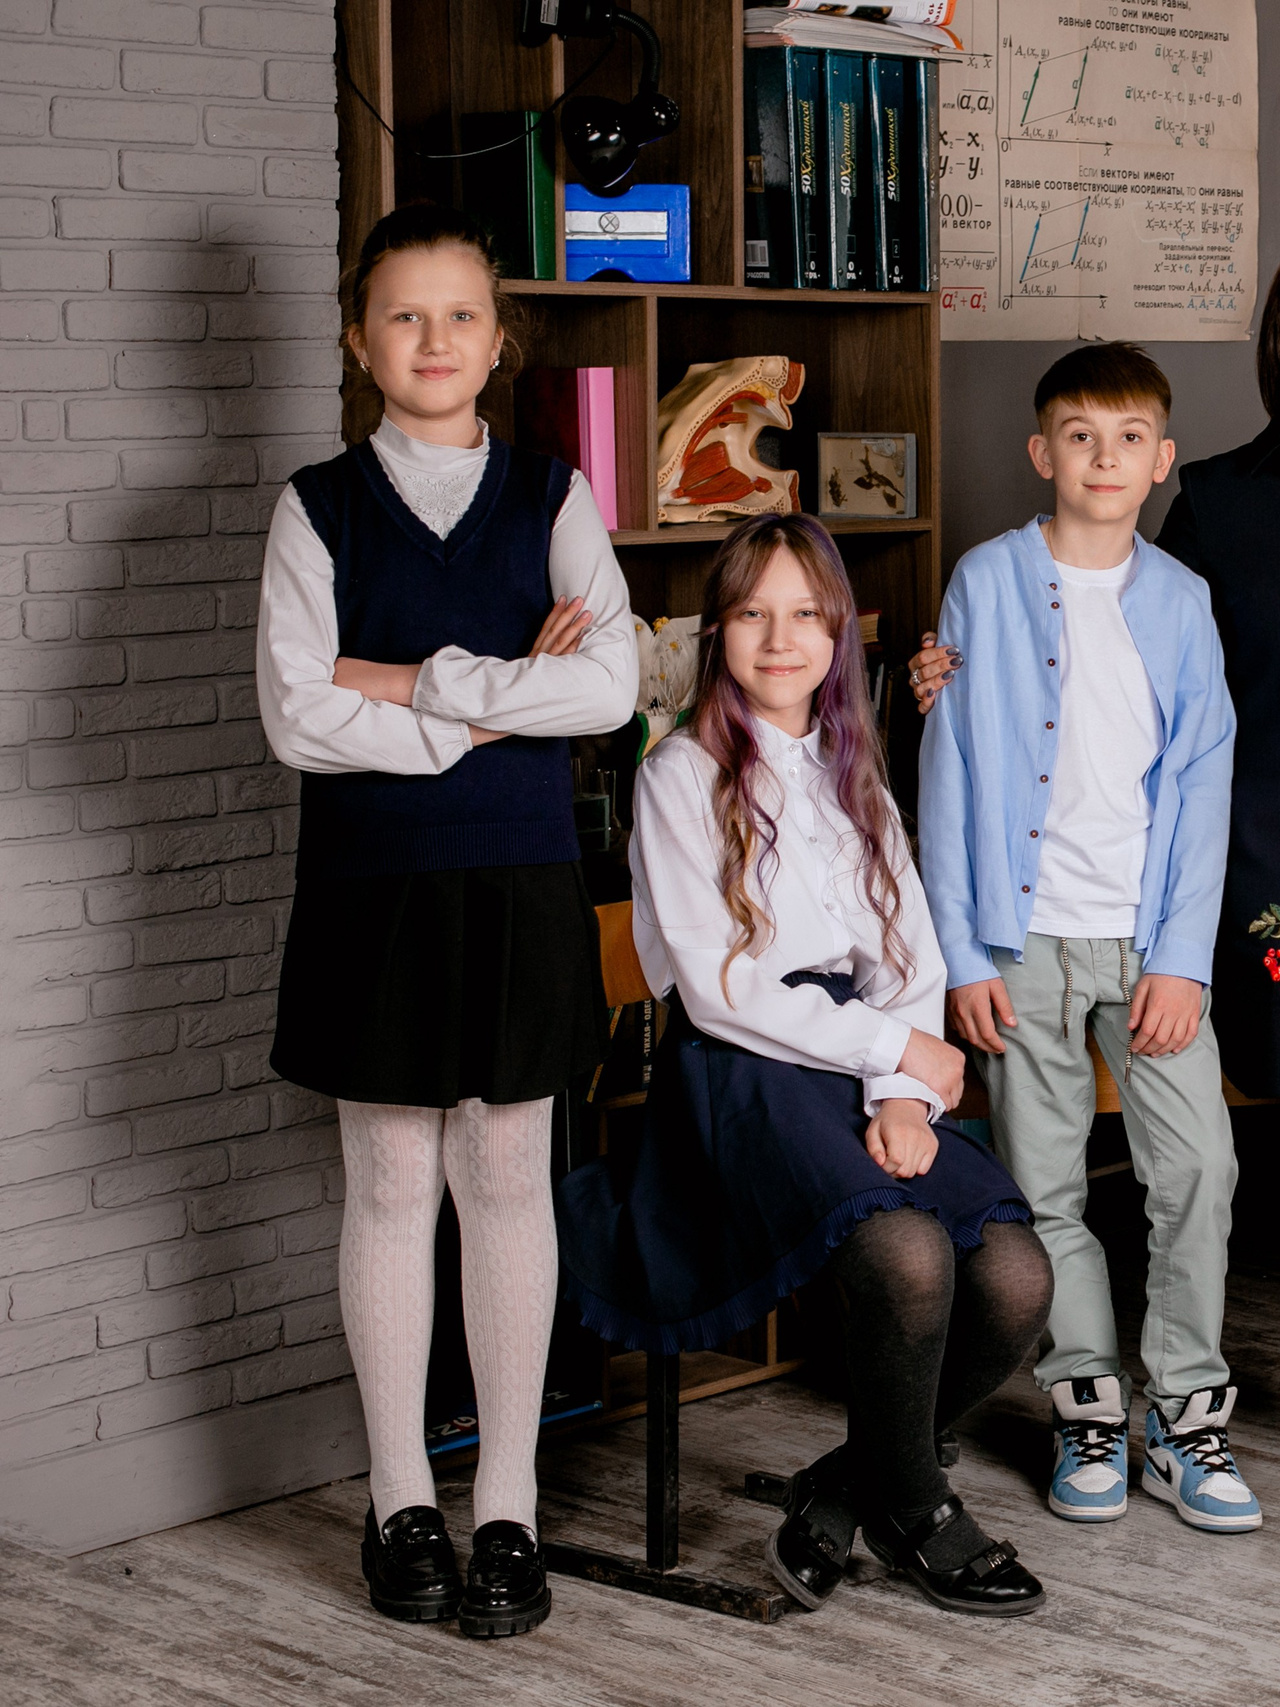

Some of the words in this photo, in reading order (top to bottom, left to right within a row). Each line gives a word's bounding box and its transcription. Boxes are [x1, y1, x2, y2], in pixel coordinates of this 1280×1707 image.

[1122, 8, 1138, 19] они
[1142, 11, 1174, 22] имеют
[1058, 16, 1092, 28] равные
[1095, 19, 1176, 37] соответствующие
[1179, 28, 1230, 42] координаты
[1100, 169, 1140, 180] векторы
[1144, 171, 1174, 181] имеют
[1005, 179, 1041, 189] равные
[1044, 180, 1128, 193] соответствующие
[1131, 185, 1184, 196] координаты,
[1199, 187, 1215, 196] они
[1217, 188, 1244, 197] равны
[953, 220, 992, 230] вектор
[1134, 301, 1184, 309] следовательно,
